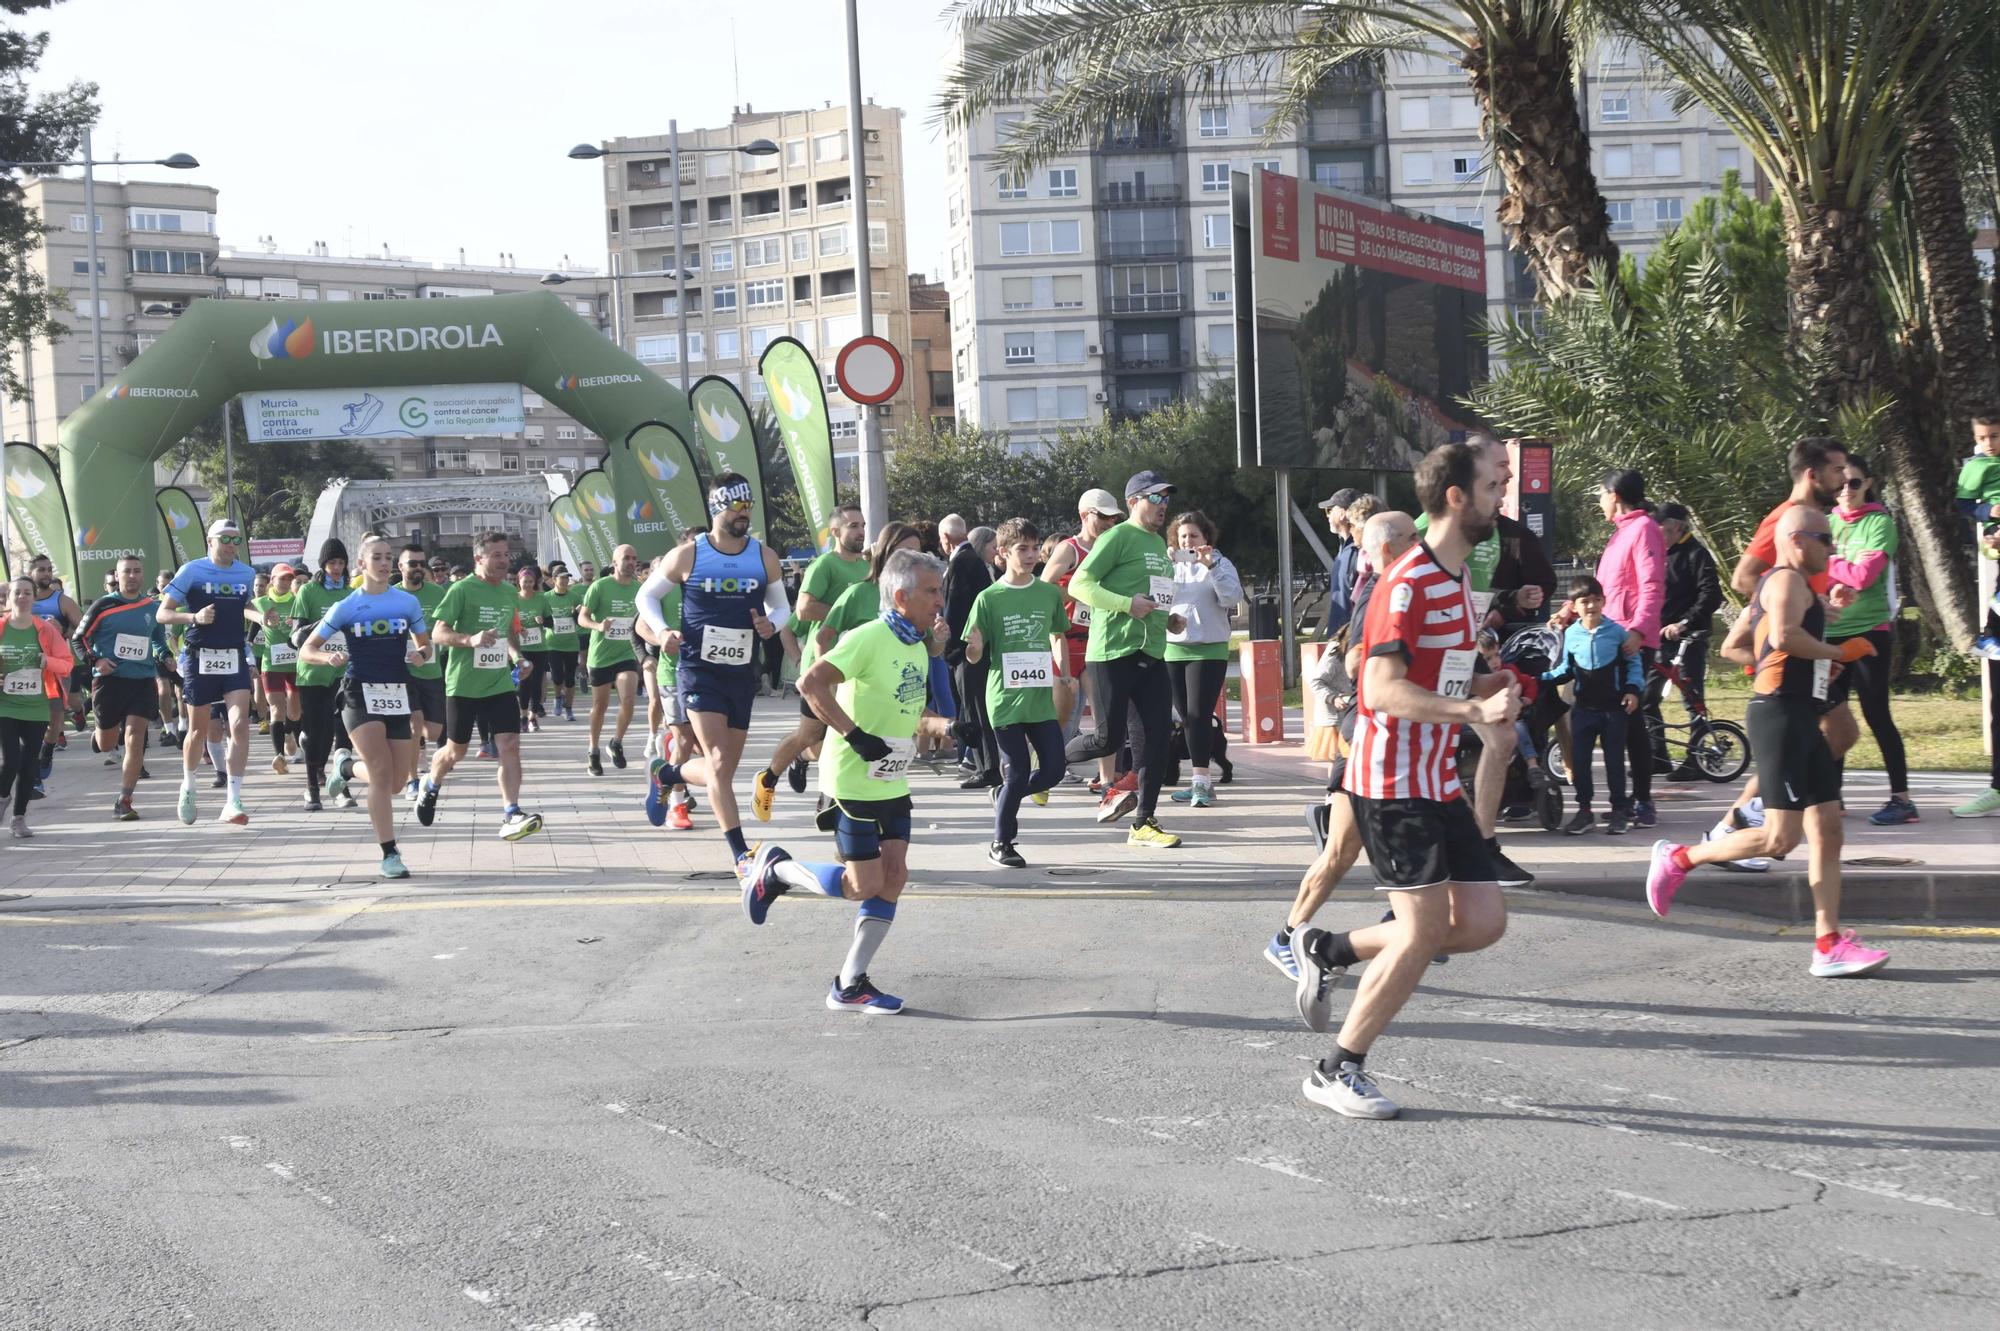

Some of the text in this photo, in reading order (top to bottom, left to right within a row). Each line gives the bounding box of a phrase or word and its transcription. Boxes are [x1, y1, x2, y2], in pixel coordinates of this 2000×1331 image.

[1318, 203, 1355, 232] MURCIA
[1386, 228, 1396, 241] DE
[1454, 244, 1480, 262] MEJORA
[1360, 240, 1371, 255] DE
[1372, 244, 1387, 258] LOS
[1427, 256, 1440, 270] DEL
[322, 323, 504, 354] IBERDROLA
[578, 374, 642, 388] IBERDROLA
[129, 387, 199, 398] IBERDROLA
[260, 398, 298, 409] Murcia
[278, 407, 320, 417] marcha
[433, 408, 460, 416] contra
[262, 418, 298, 427] contra
[434, 418, 445, 426] en
[446, 417, 454, 425] la
[486, 416, 496, 424] de
[263, 428, 274, 436] el
[77, 547, 146, 560] IBERDROLA
[120, 646, 144, 656] 0710
[275, 652, 297, 660] 2225
[707, 644, 745, 659] 2405
[206, 660, 232, 669] 2421
[1011, 669, 1046, 680] 0440
[10, 681, 37, 690] 1214
[372, 699, 402, 709] 2353
